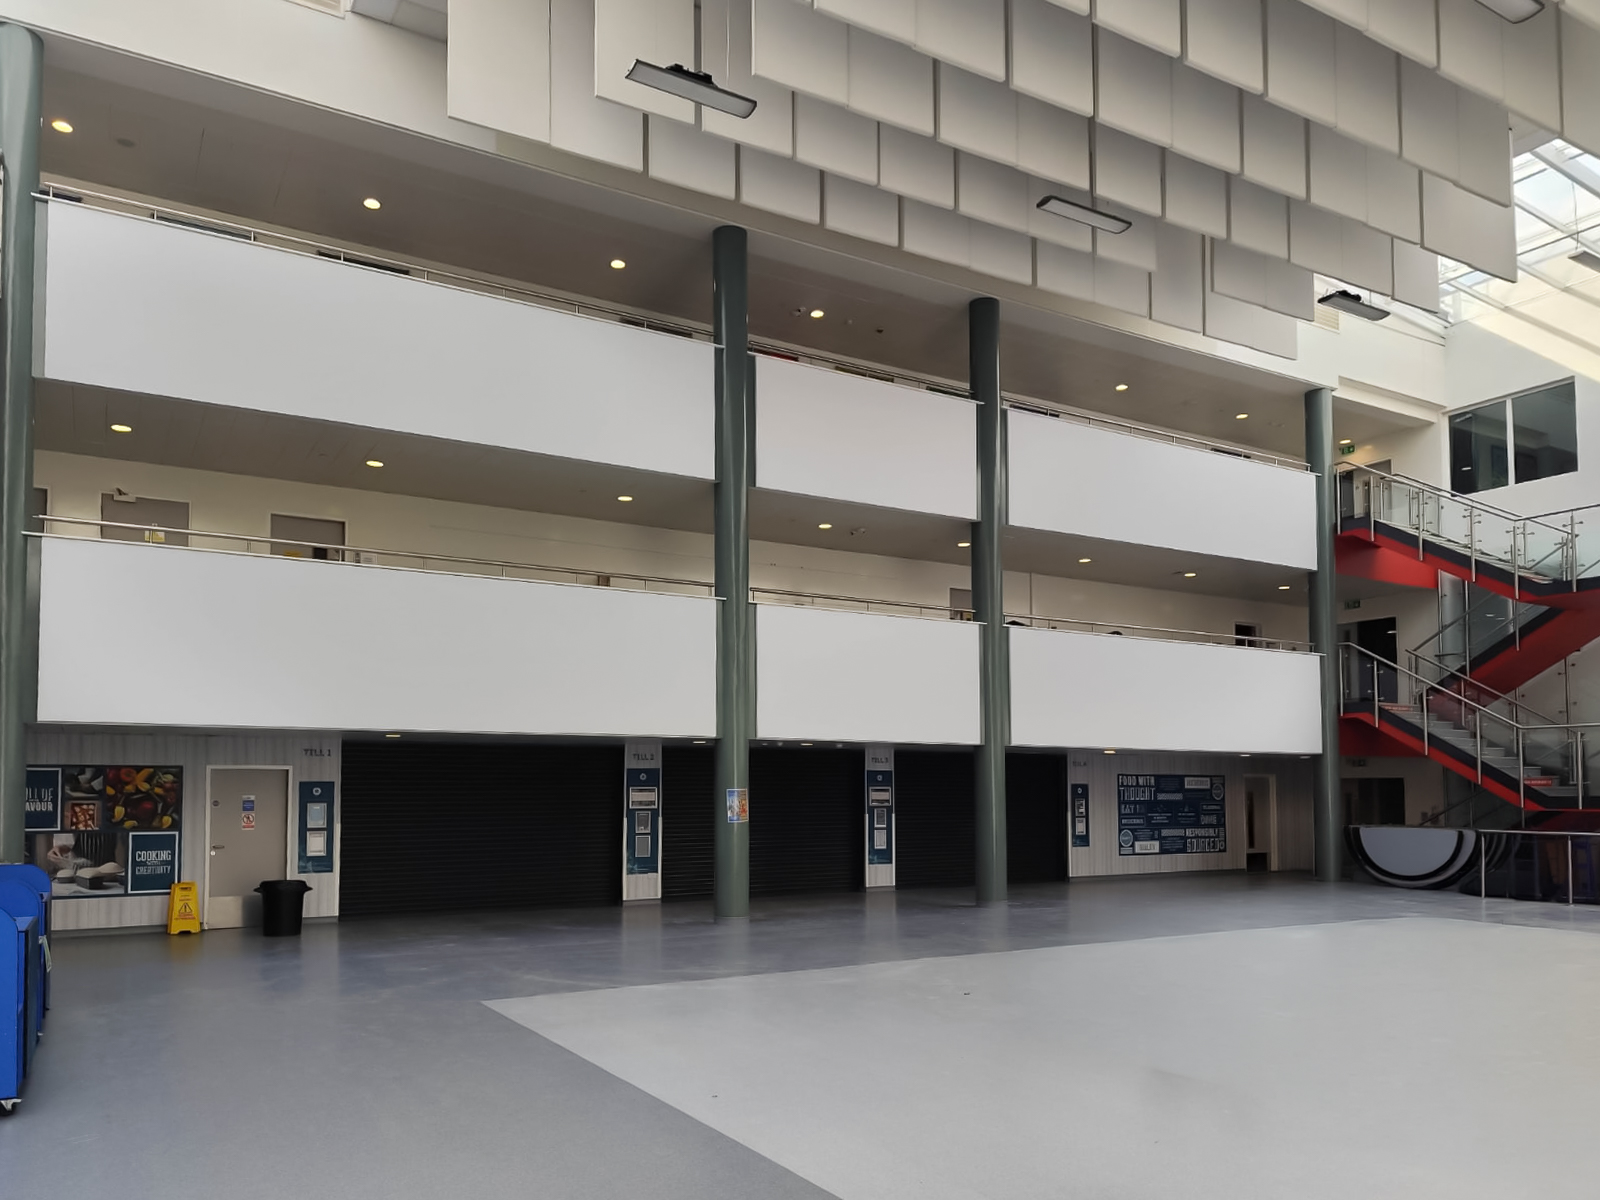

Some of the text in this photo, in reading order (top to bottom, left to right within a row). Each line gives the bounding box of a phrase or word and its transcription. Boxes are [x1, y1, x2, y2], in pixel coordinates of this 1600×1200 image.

[1119, 775, 1137, 786] FOOD
[1138, 775, 1155, 786] WITH
[41, 787, 54, 802] OF
[1119, 787, 1156, 801] THOUGHT
[1186, 838, 1219, 853] SOURCED
[135, 850, 172, 862] COOKING
[135, 865, 171, 875] CREATIVITY
